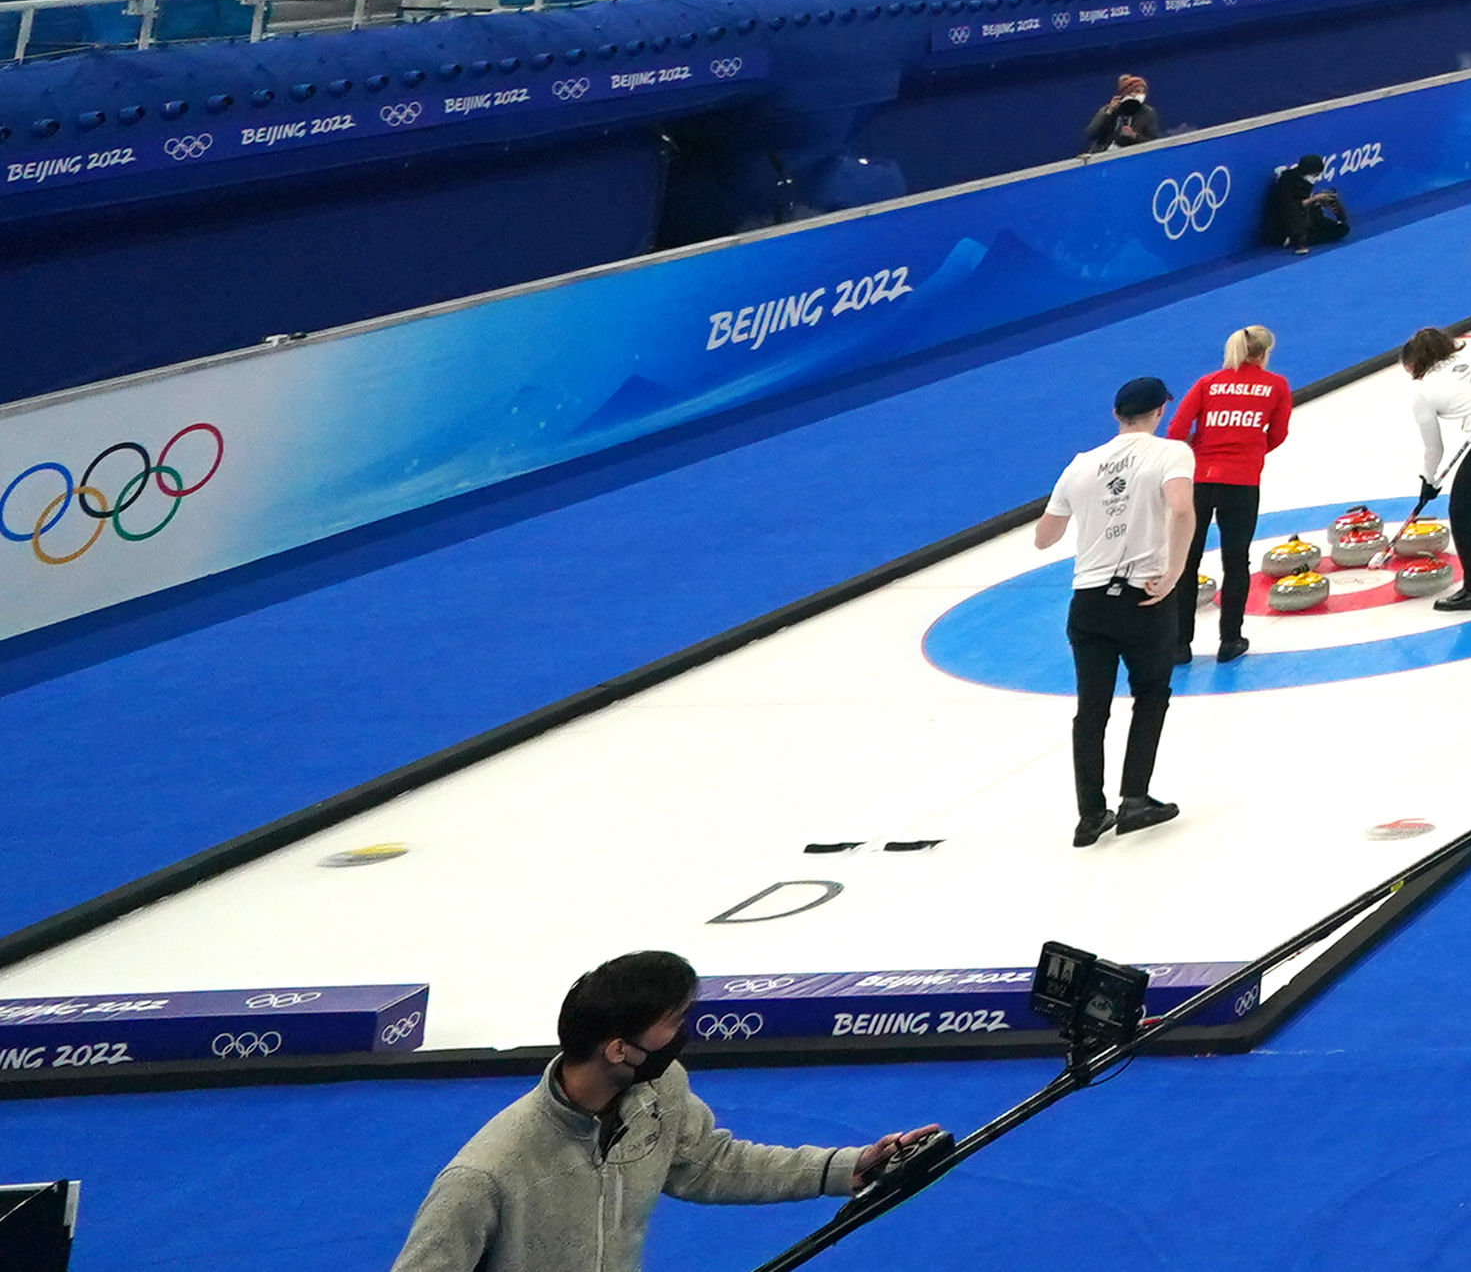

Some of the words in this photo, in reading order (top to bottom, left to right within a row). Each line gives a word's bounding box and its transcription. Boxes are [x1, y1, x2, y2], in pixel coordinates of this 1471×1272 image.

[1079, 8, 1108, 23] BEIJING
[1110, 6, 1130, 17] 2022
[982, 22, 1015, 37] BEIJING
[1018, 19, 1040, 31] 2022
[611, 71, 656, 90] BEIJING
[659, 67, 691, 82] 2022
[445, 93, 491, 115] BEIJING
[494, 88, 530, 105] 2022
[242, 122, 306, 145] BEIJING
[311, 115, 356, 134] 2022
[8, 156, 81, 182] BEIJING
[87, 148, 135, 169] 2022
[1340, 143, 1384, 175] 2022
[706, 294, 825, 350] BEIJING
[834, 266, 913, 309] 2022
[1209, 383, 1272, 397] SKASLIEN
[1207, 410, 1263, 428] NORGE
[1097, 455, 1137, 477] MOUAT
[1105, 523, 1127, 540] GBR
[705, 880, 844, 924] D
[833, 1012, 930, 1035] BEIJING
[937, 1010, 1009, 1032] 2022
[52, 1043, 132, 1067] 2022
